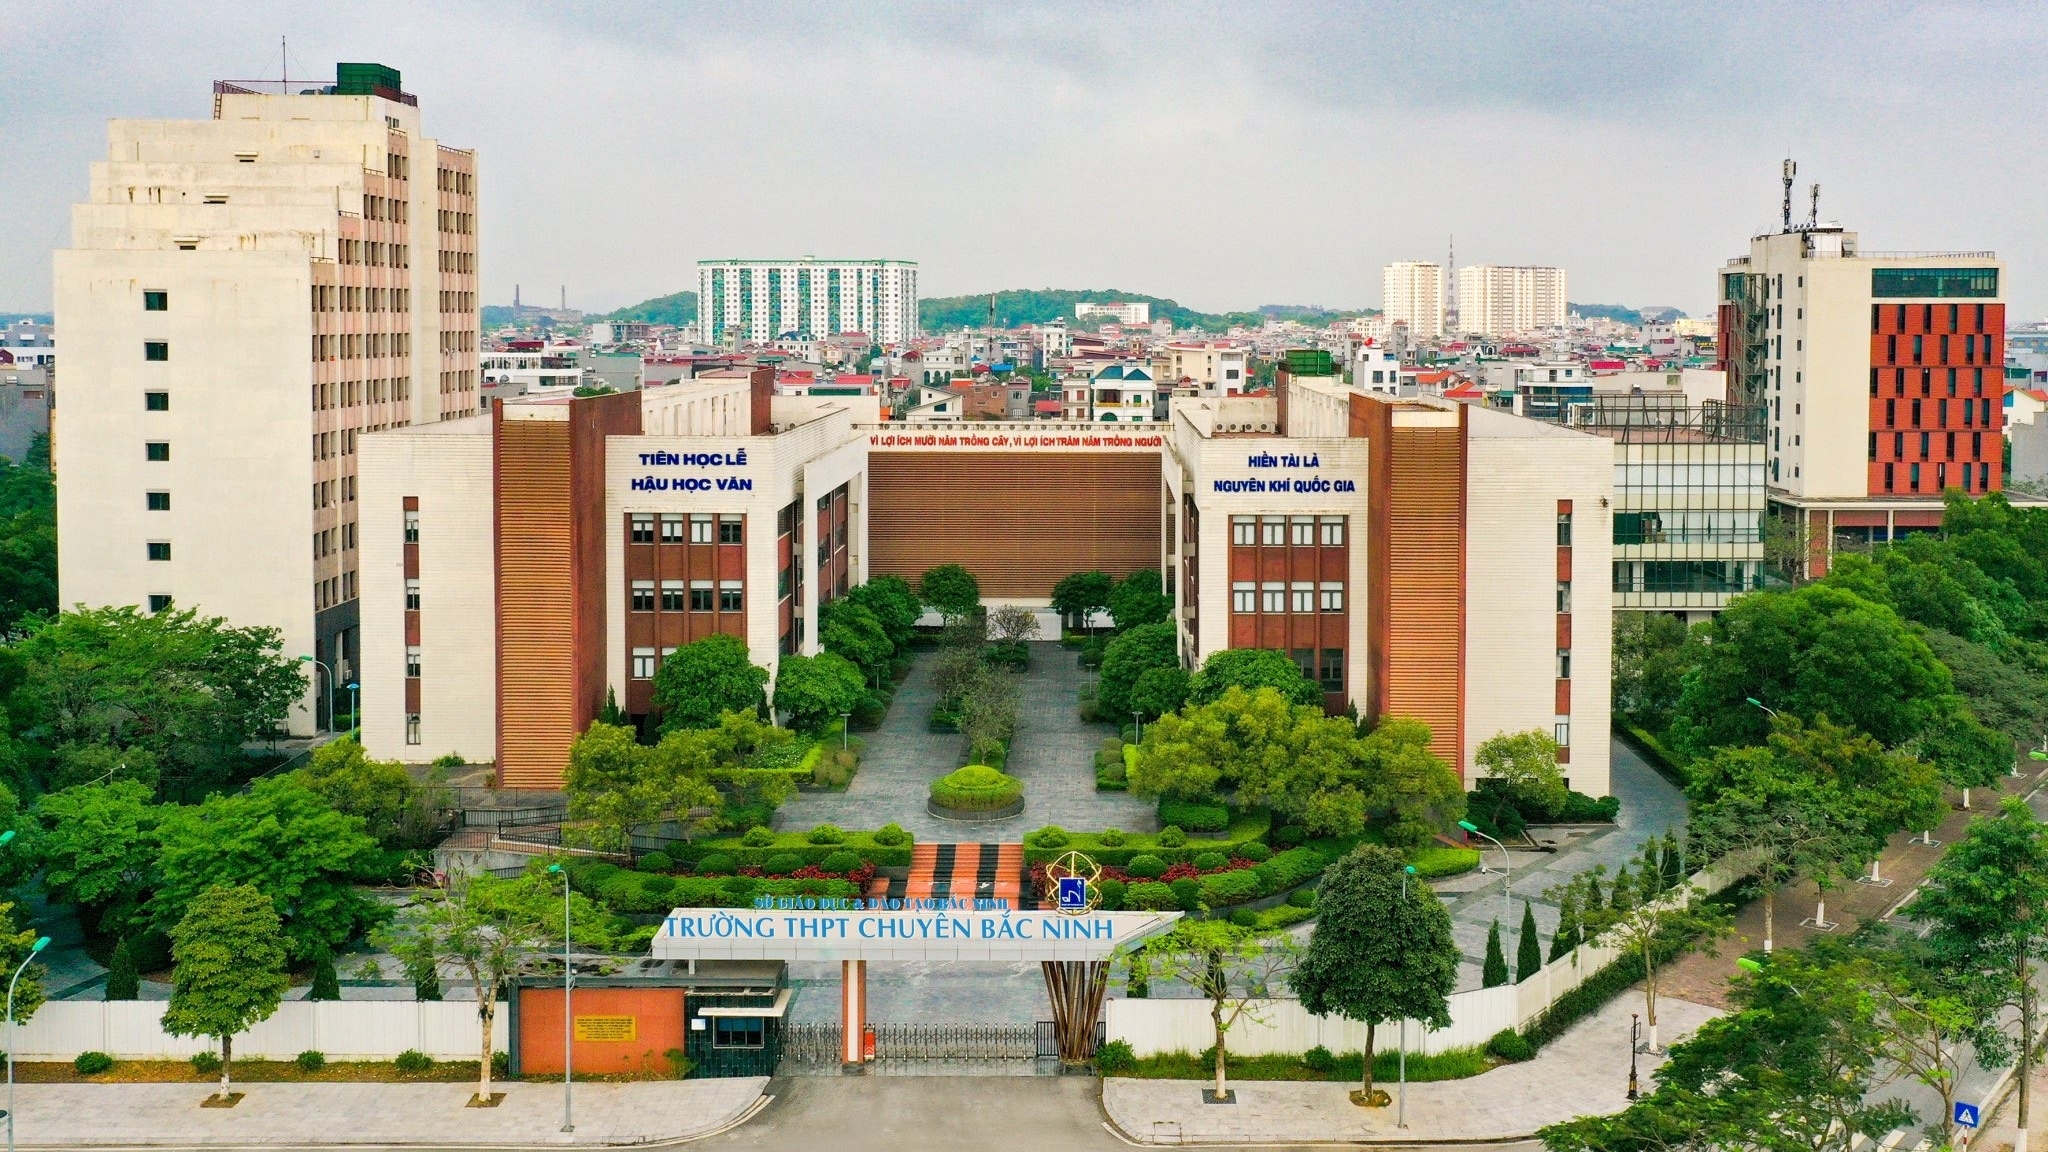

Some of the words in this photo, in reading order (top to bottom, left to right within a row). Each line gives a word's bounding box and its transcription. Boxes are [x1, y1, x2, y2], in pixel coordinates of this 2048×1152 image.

[870, 435, 879, 446] VÌ
[881, 436, 895, 447] LỢI
[897, 434, 912, 446] ÍCH
[914, 435, 936, 446] MƯỜI
[960, 433, 990, 446] TRỒNG
[1013, 435, 1022, 446] VÌ
[1024, 436, 1038, 448] LỢI
[1040, 434, 1055, 446] ÍCH
[1102, 434, 1133, 447] TRỒNG
[1135, 435, 1162, 447] NGƯỜI
[639, 451, 679, 466] TIÊN
[683, 453, 723, 469] HỌC
[726, 448, 747, 466] LỄ
[1248, 451, 1278, 467] HIỀN
[1281, 453, 1300, 467] TÀI
[1304, 453, 1319, 467] LÀ
[632, 476, 668, 493] HẬU
[672, 478, 711, 493] HỌC
[716, 477, 752, 491] VĂN
[1214, 478, 1266, 492] NGUYÊN
[1269, 477, 1291, 492] KHÍ
[1294, 476, 1330, 493] QUỐC
[1334, 480, 1355, 492] GIA
[754, 893, 774, 910] SỞ
[777, 895, 816, 910] GIÁO
[820, 897, 850, 912] DỤC
[853, 898, 865, 910] &
[904, 897, 935, 912] TẠO
[937, 893, 968, 910] BẮC
[973, 898, 1009, 910] NINH
[665, 911, 775, 938] TRƯỜNG
[784, 917, 849, 938] THPT
[858, 912, 971, 939] CHUYÊN
[982, 911, 1032, 939] BẮC
[1042, 918, 1113, 939] NINH
